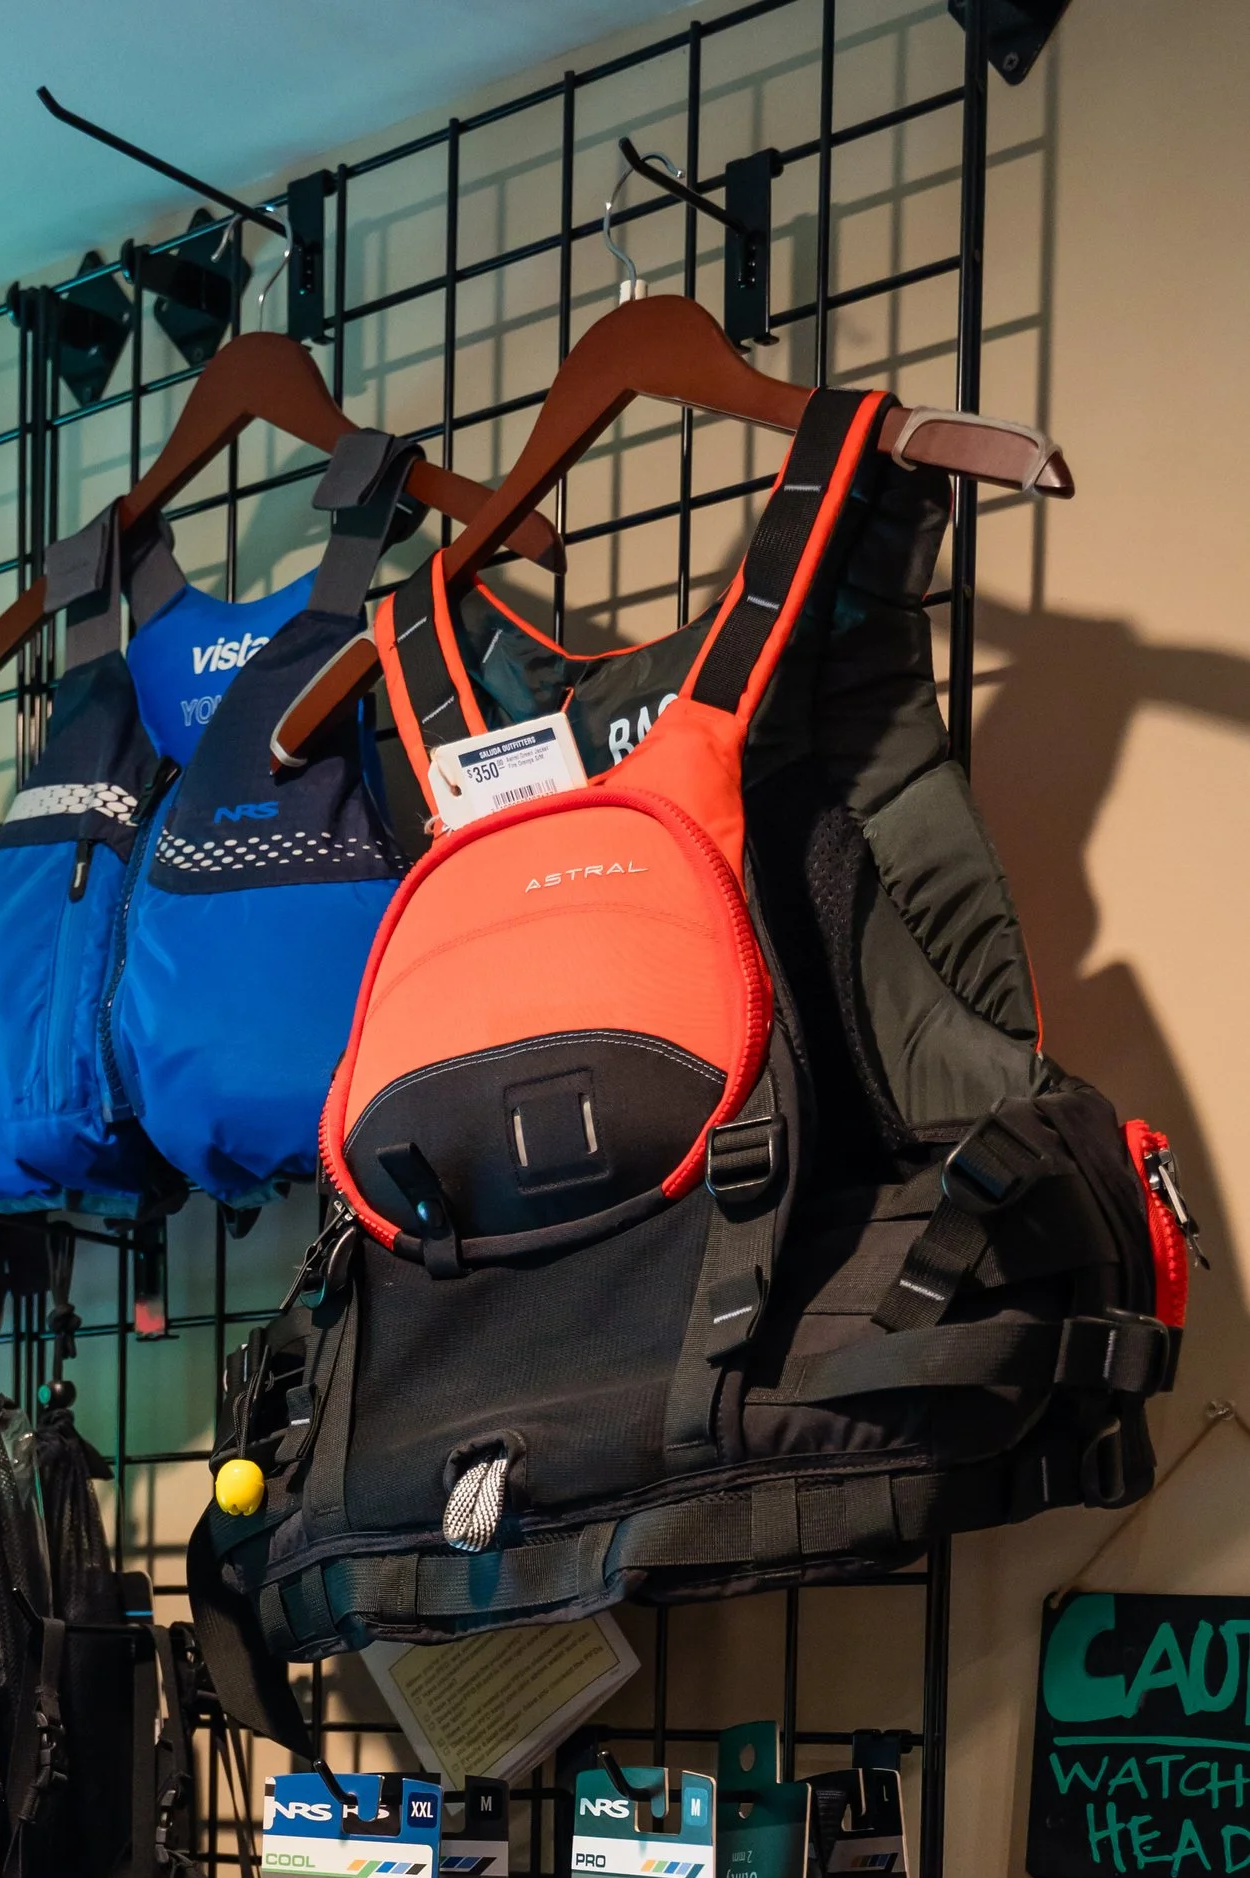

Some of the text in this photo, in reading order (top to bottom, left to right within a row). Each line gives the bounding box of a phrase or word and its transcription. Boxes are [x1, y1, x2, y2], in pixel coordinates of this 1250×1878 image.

[479, 736, 536, 759] SALUDA OUTFITTERS
[213, 801, 279, 824] NRS
[525, 860, 650, 893] ASTRAL
[1049, 1752, 1250, 1809] WATCH
[274, 1801, 333, 1822] NRS
[410, 1801, 434, 1819] XXL
[480, 1796, 493, 1812] M
[579, 1798, 630, 1819] NRS
[690, 1798, 700, 1817] M
[265, 1853, 316, 1868] COOL
[576, 1853, 606, 1868] PRO
[732, 1850, 753, 1863] 2 mm
